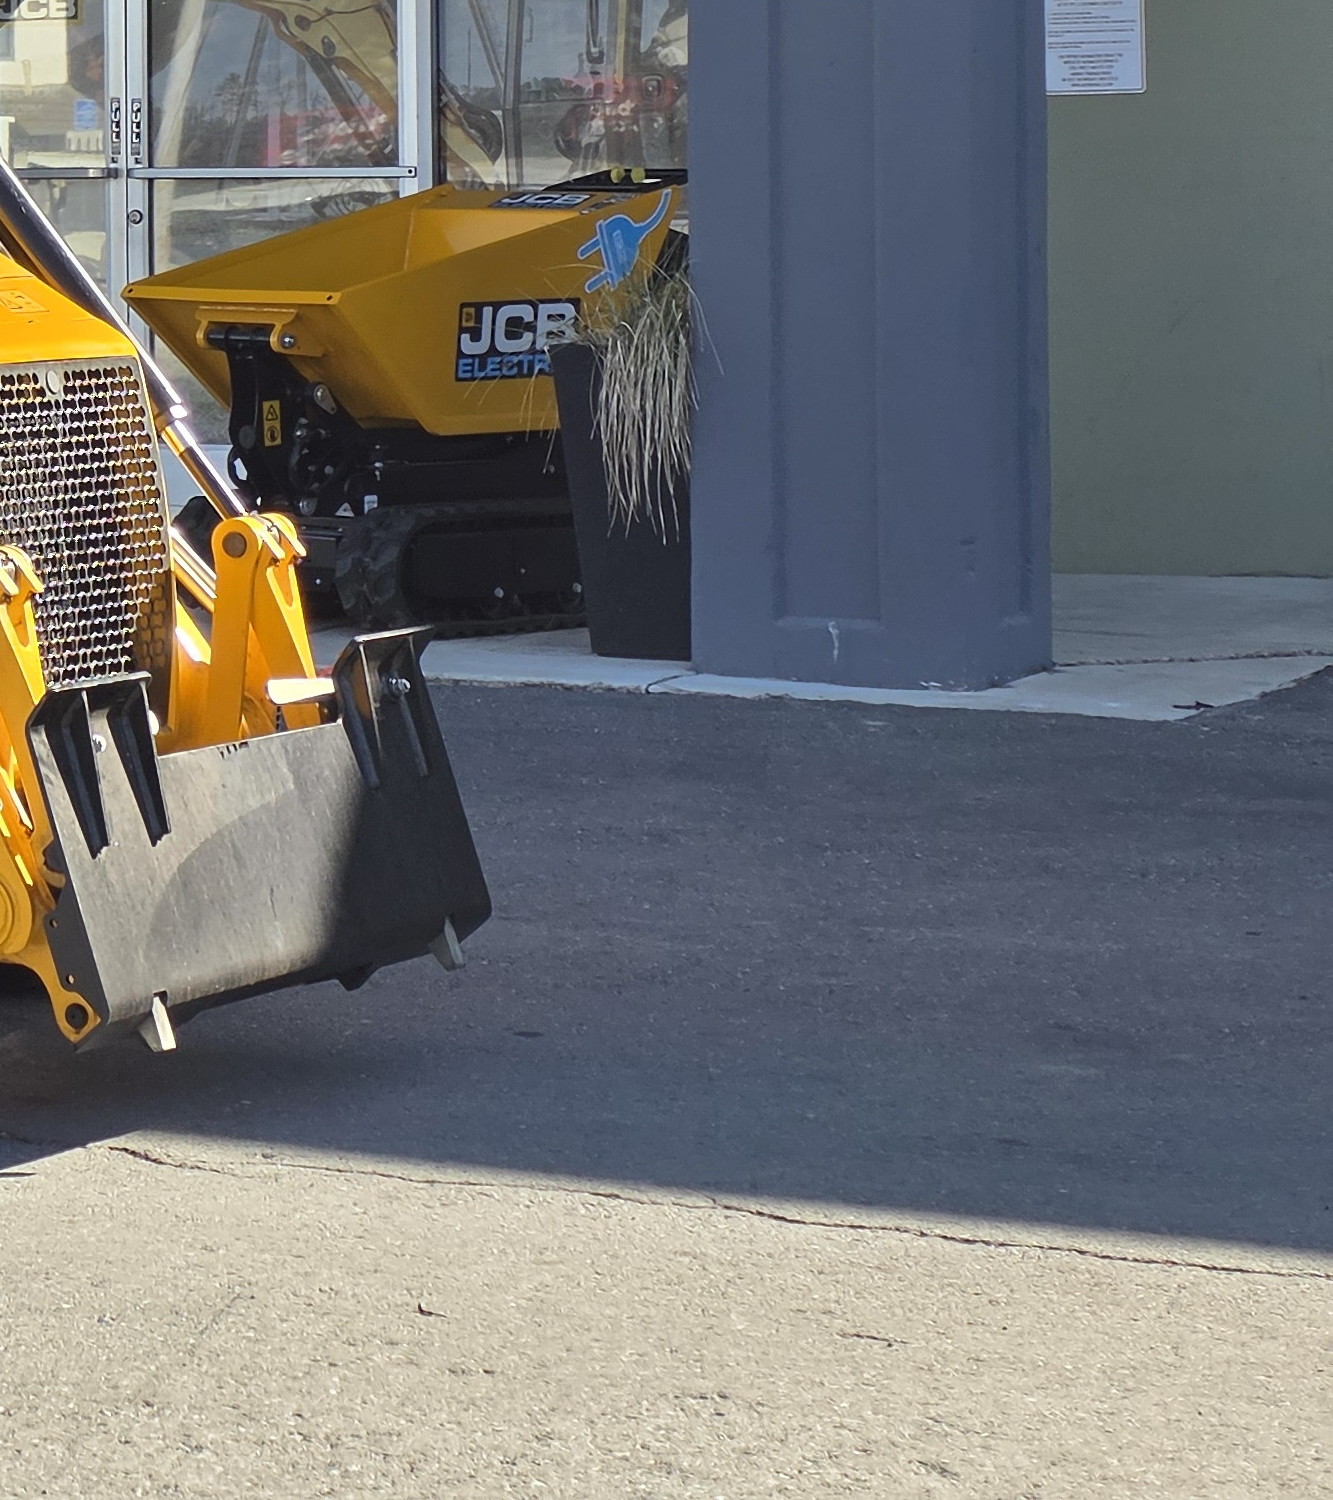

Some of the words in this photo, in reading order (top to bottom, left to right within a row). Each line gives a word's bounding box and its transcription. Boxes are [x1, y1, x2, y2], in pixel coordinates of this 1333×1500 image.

[112, 102, 120, 142] PULL
[133, 102, 141, 142] PULL
[500, 194, 591, 205] JCB
[460, 302, 576, 355] JCB
